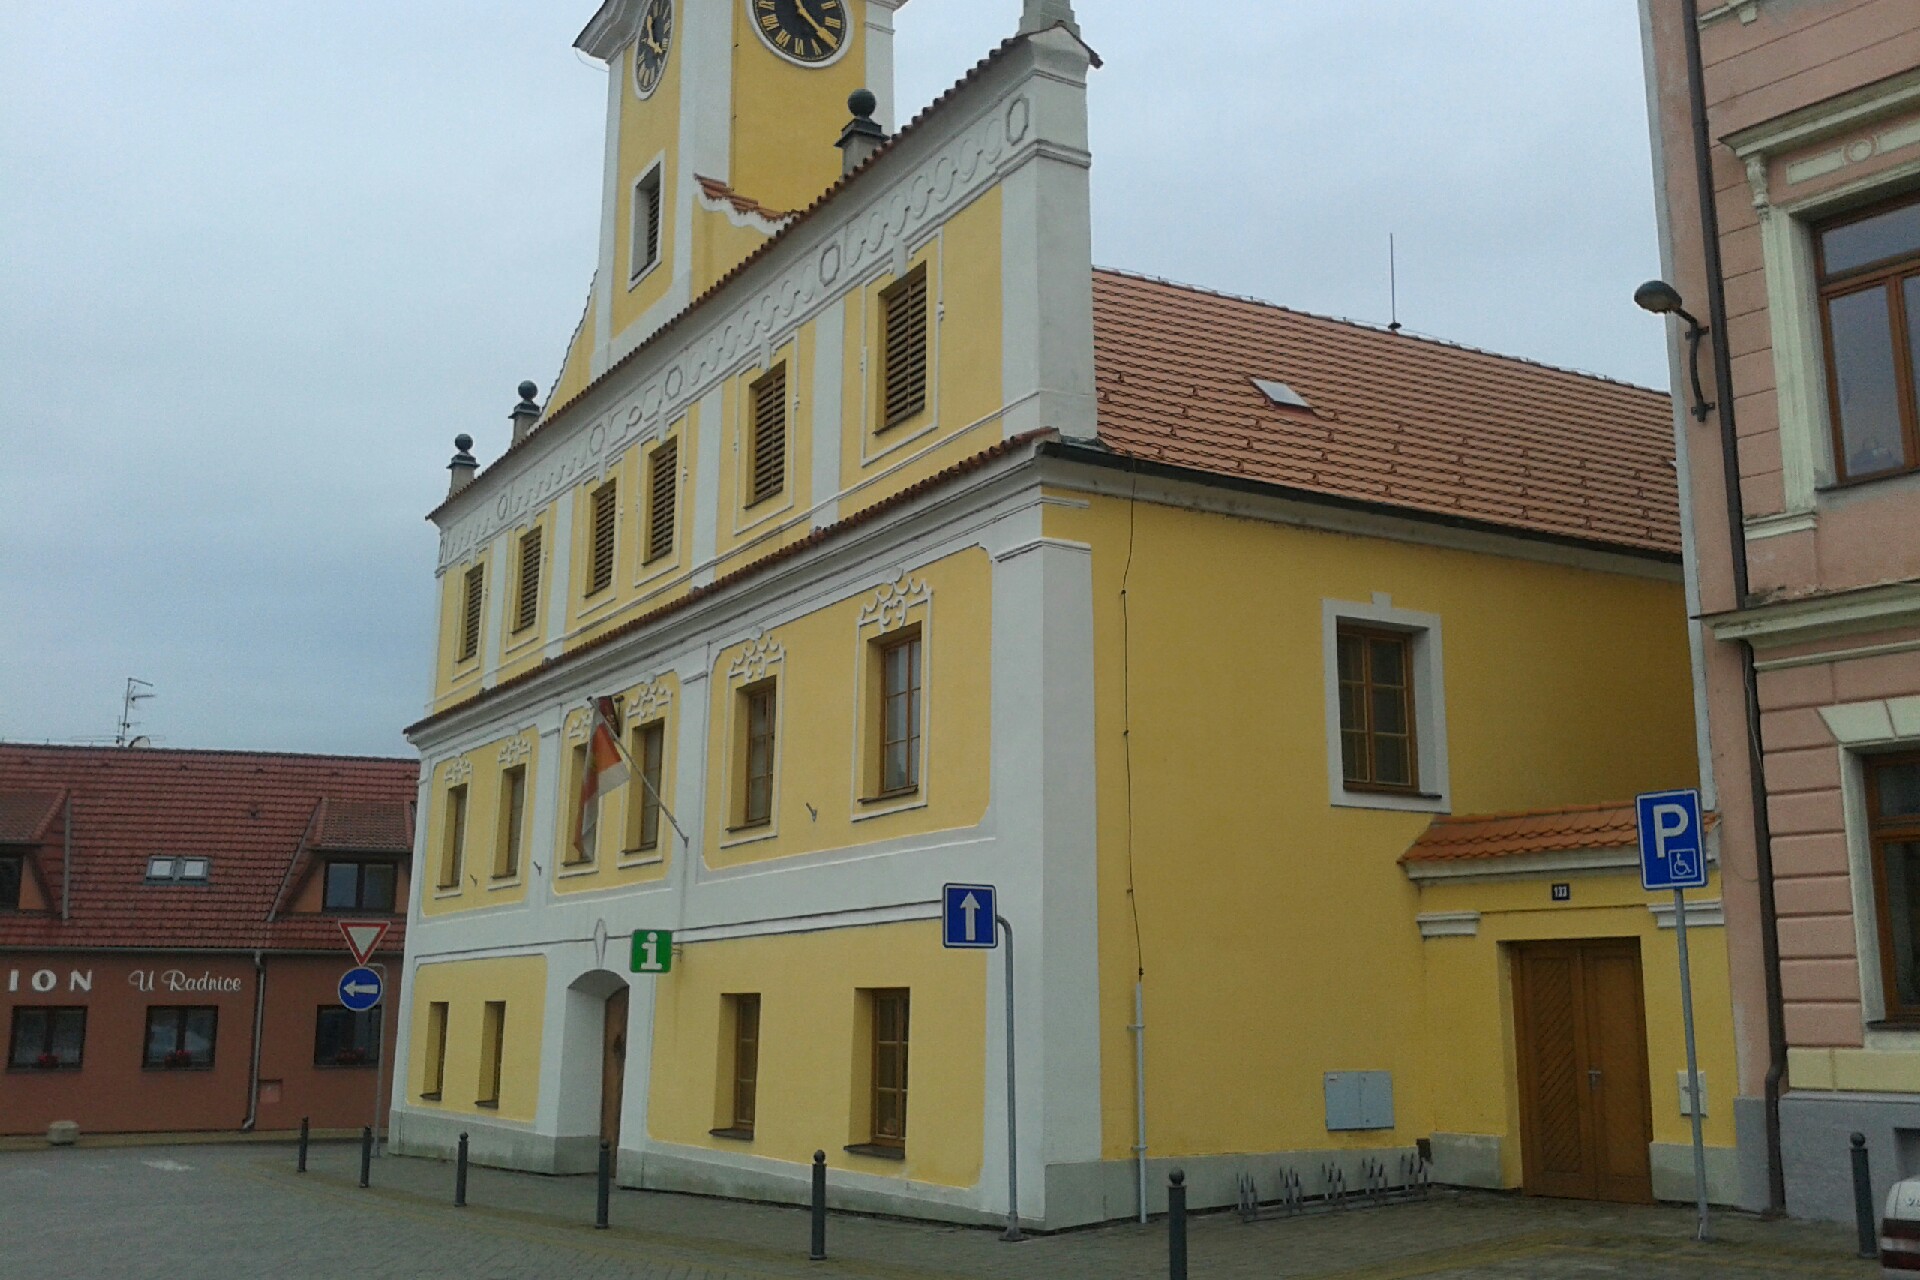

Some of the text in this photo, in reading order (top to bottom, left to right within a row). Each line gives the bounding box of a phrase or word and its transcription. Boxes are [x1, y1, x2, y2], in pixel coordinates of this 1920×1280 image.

[1653, 803, 1689, 859] P
[8, 968, 243, 992] ION U Radnice
